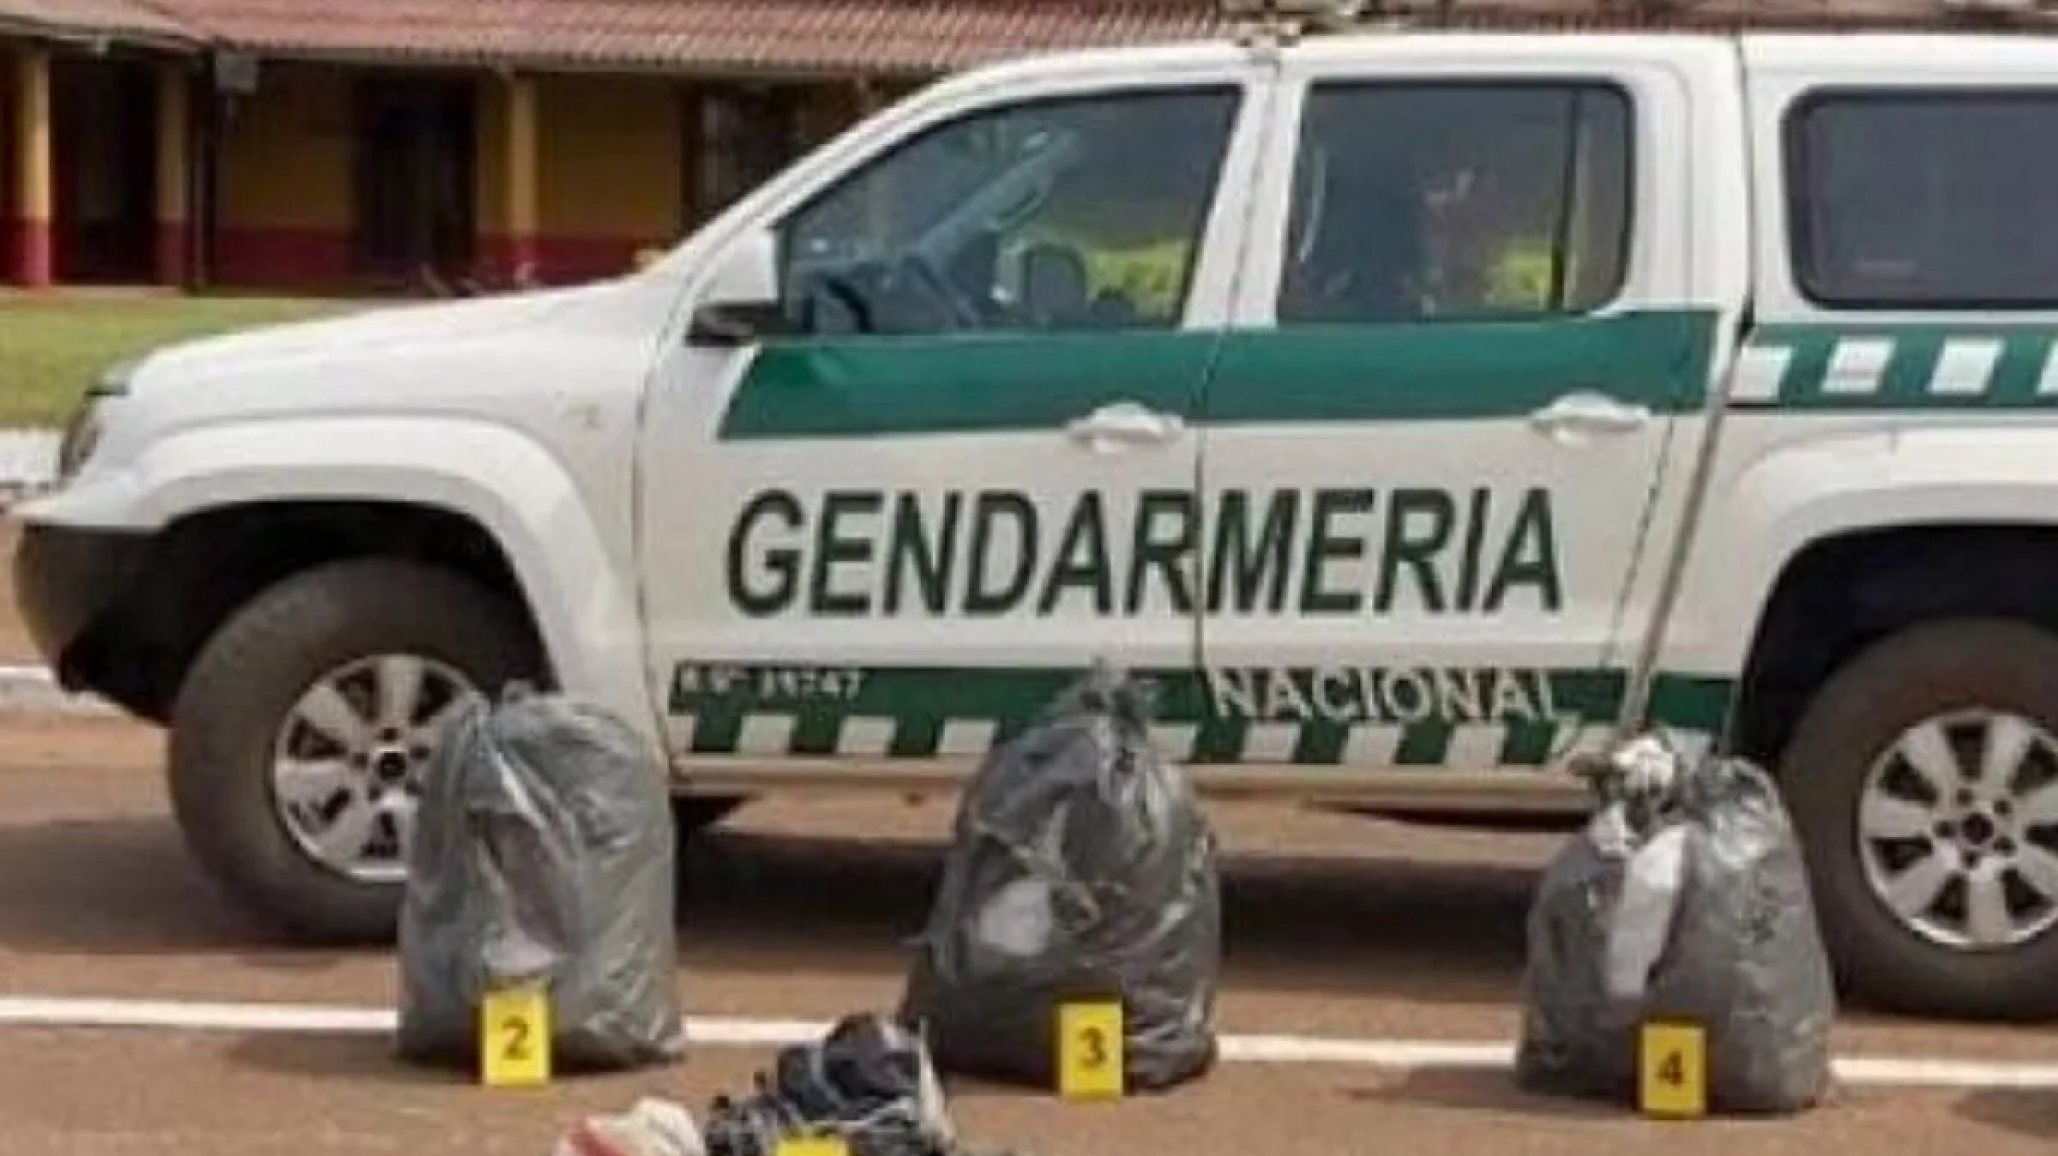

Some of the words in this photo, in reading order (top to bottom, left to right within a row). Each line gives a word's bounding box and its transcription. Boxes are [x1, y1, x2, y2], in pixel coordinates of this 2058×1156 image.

[726, 486, 1565, 619] GENDARMERIA
[1209, 665, 1576, 722] NACIONAL
[501, 1015, 530, 1061] 2
[1077, 1027, 1107, 1069] 3
[1655, 1048, 1686, 1089] 4
